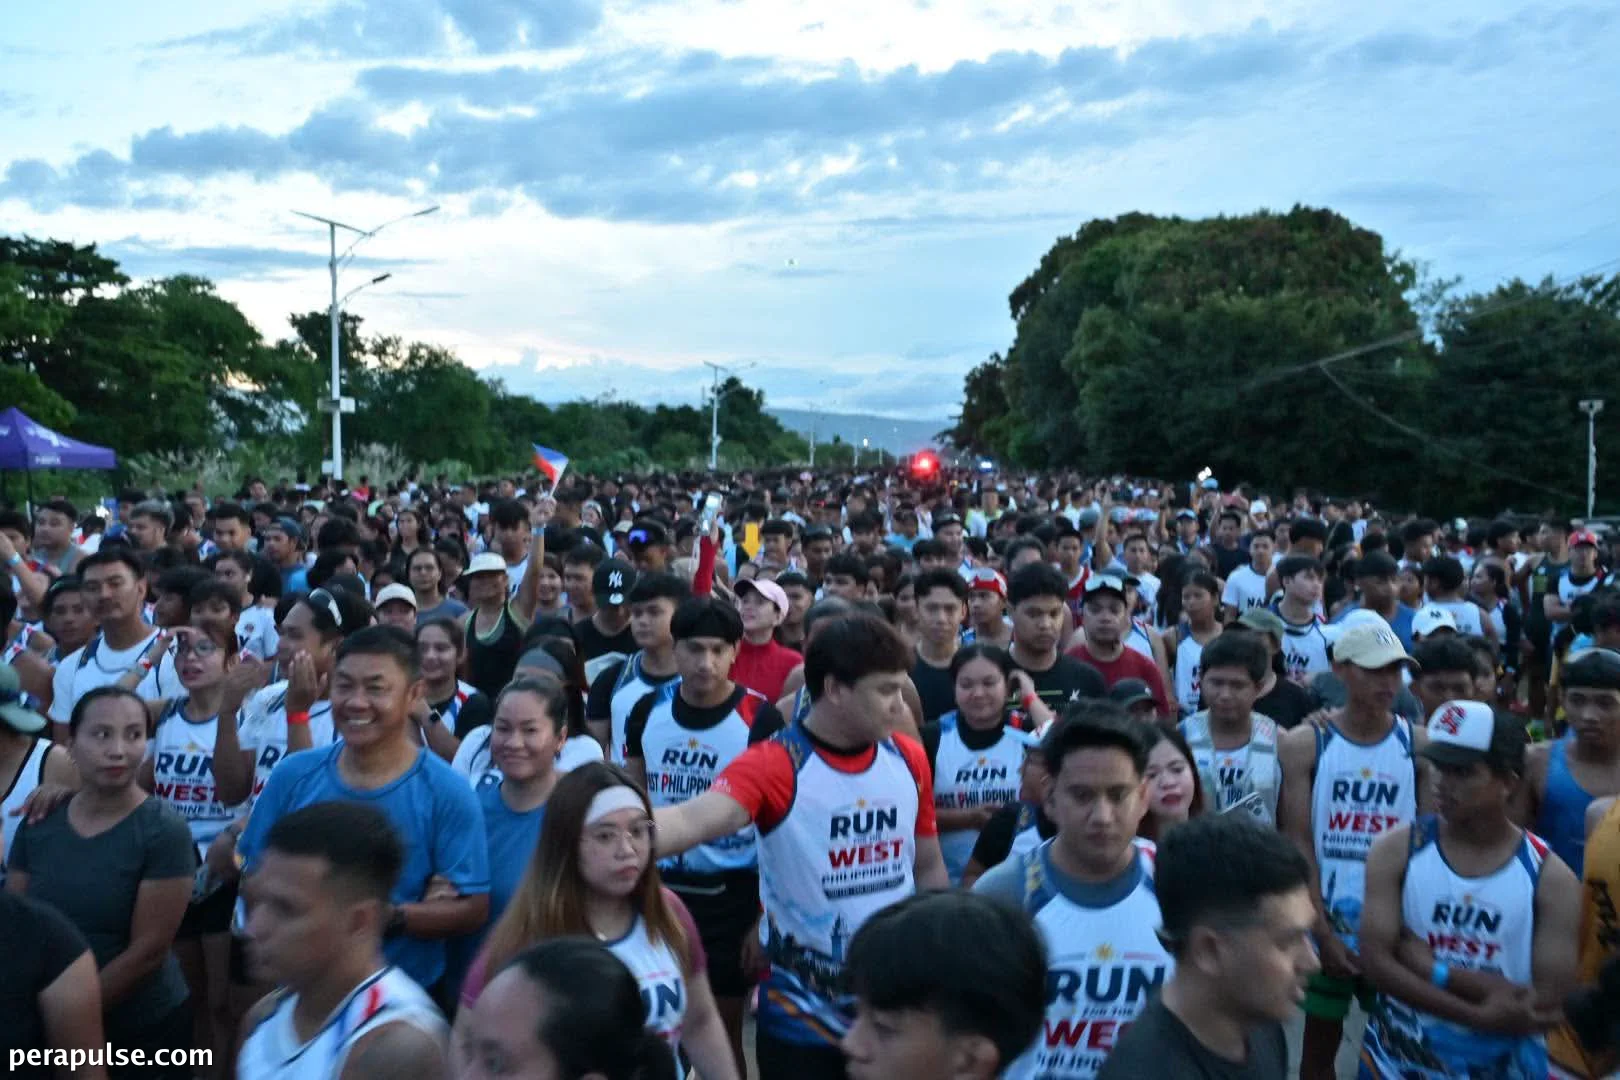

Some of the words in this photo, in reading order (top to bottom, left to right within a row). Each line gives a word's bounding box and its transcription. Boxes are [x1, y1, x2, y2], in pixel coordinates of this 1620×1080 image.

[662, 748, 719, 770] RUN
[955, 765, 1008, 784] RUN
[1332, 780, 1400, 808] RUN
[829, 806, 898, 840] RUN
[1328, 812, 1400, 834] WEST
[828, 838, 905, 869] WEST
[1431, 902, 1502, 934] RUN
[1045, 966, 1166, 1006] RUN
[1044, 1020, 1135, 1050] WE
